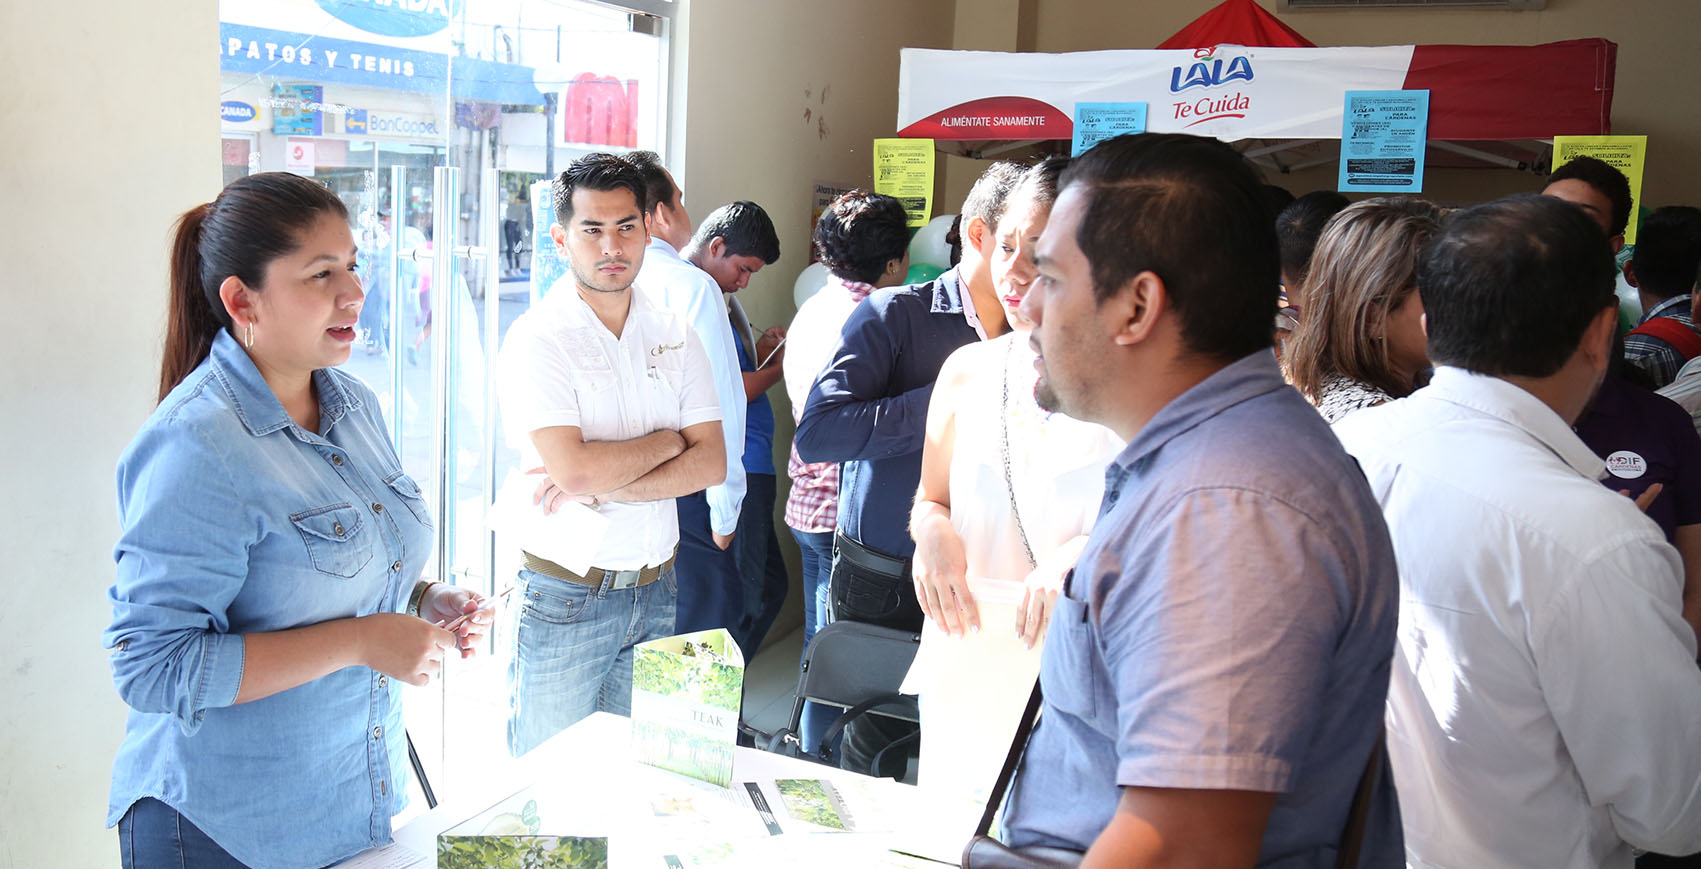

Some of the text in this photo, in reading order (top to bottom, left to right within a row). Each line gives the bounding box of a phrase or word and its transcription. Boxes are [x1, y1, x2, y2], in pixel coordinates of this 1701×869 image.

[219, 37, 415, 77] PATOS Y TENIS
[1170, 56, 1255, 93] LALA
[1172, 92, 1251, 119] Te Cuida
[369, 114, 440, 136] BanCoppel
[940, 115, 1046, 127] ALIMÉNTATE SANAMENTE
[691, 710, 727, 728] TEAK
